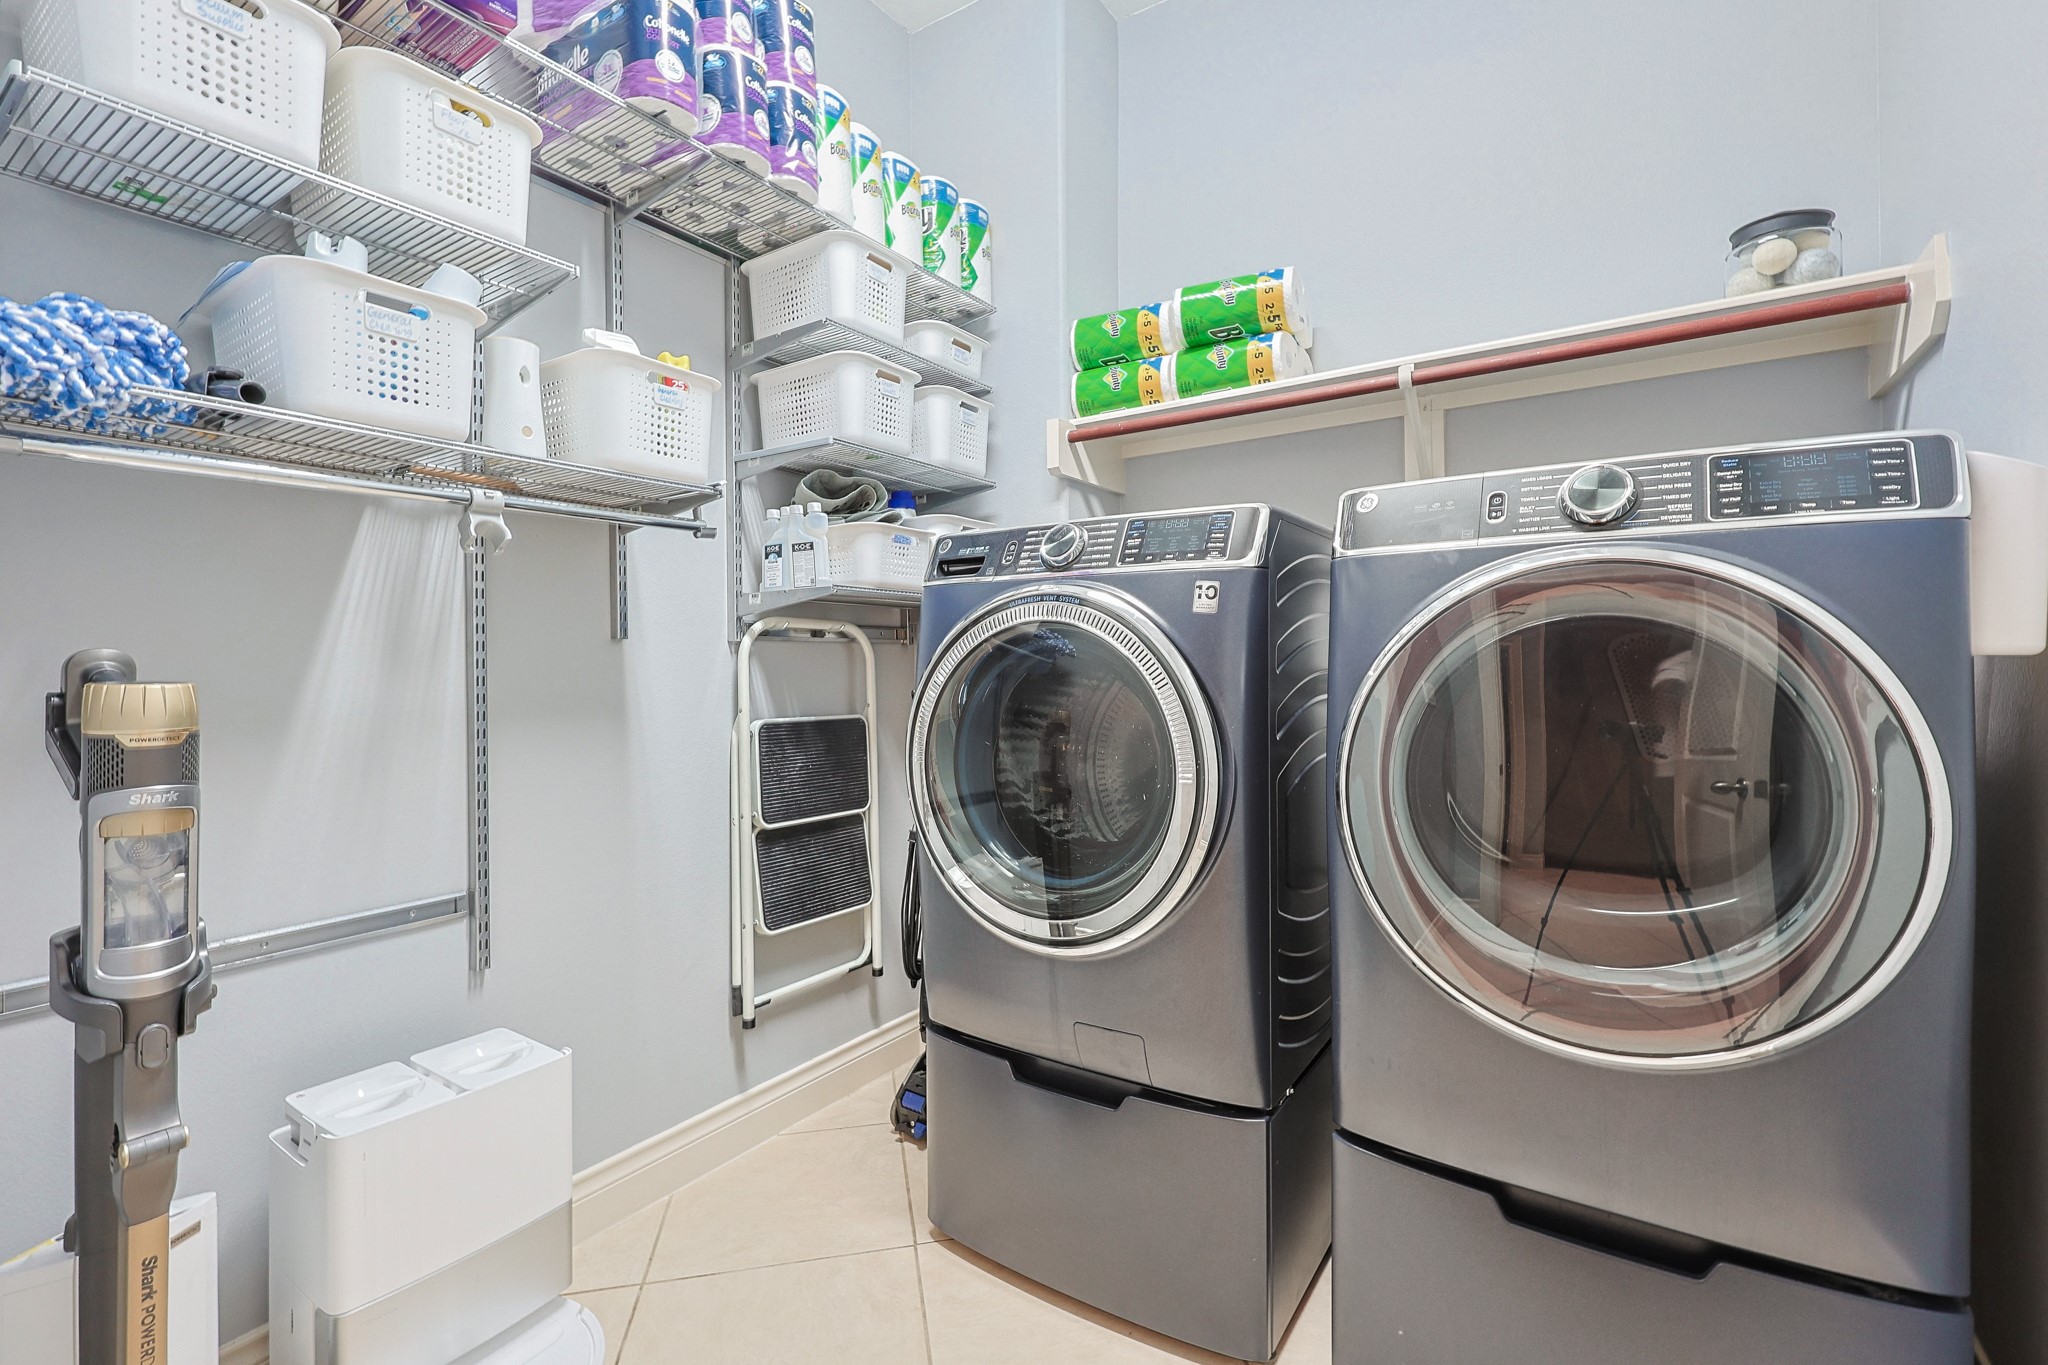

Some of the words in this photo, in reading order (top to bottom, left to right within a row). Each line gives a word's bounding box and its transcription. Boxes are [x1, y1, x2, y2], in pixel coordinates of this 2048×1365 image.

[645, 14, 690, 47] Cotonelle
[1008, 595, 1040, 608] ULTRAFRESH
[1060, 595, 1080, 604] SYSTEM
[129, 735, 180, 743] POWERDETECT
[128, 790, 180, 805] Shark
[141, 1255, 158, 1302] Shark
